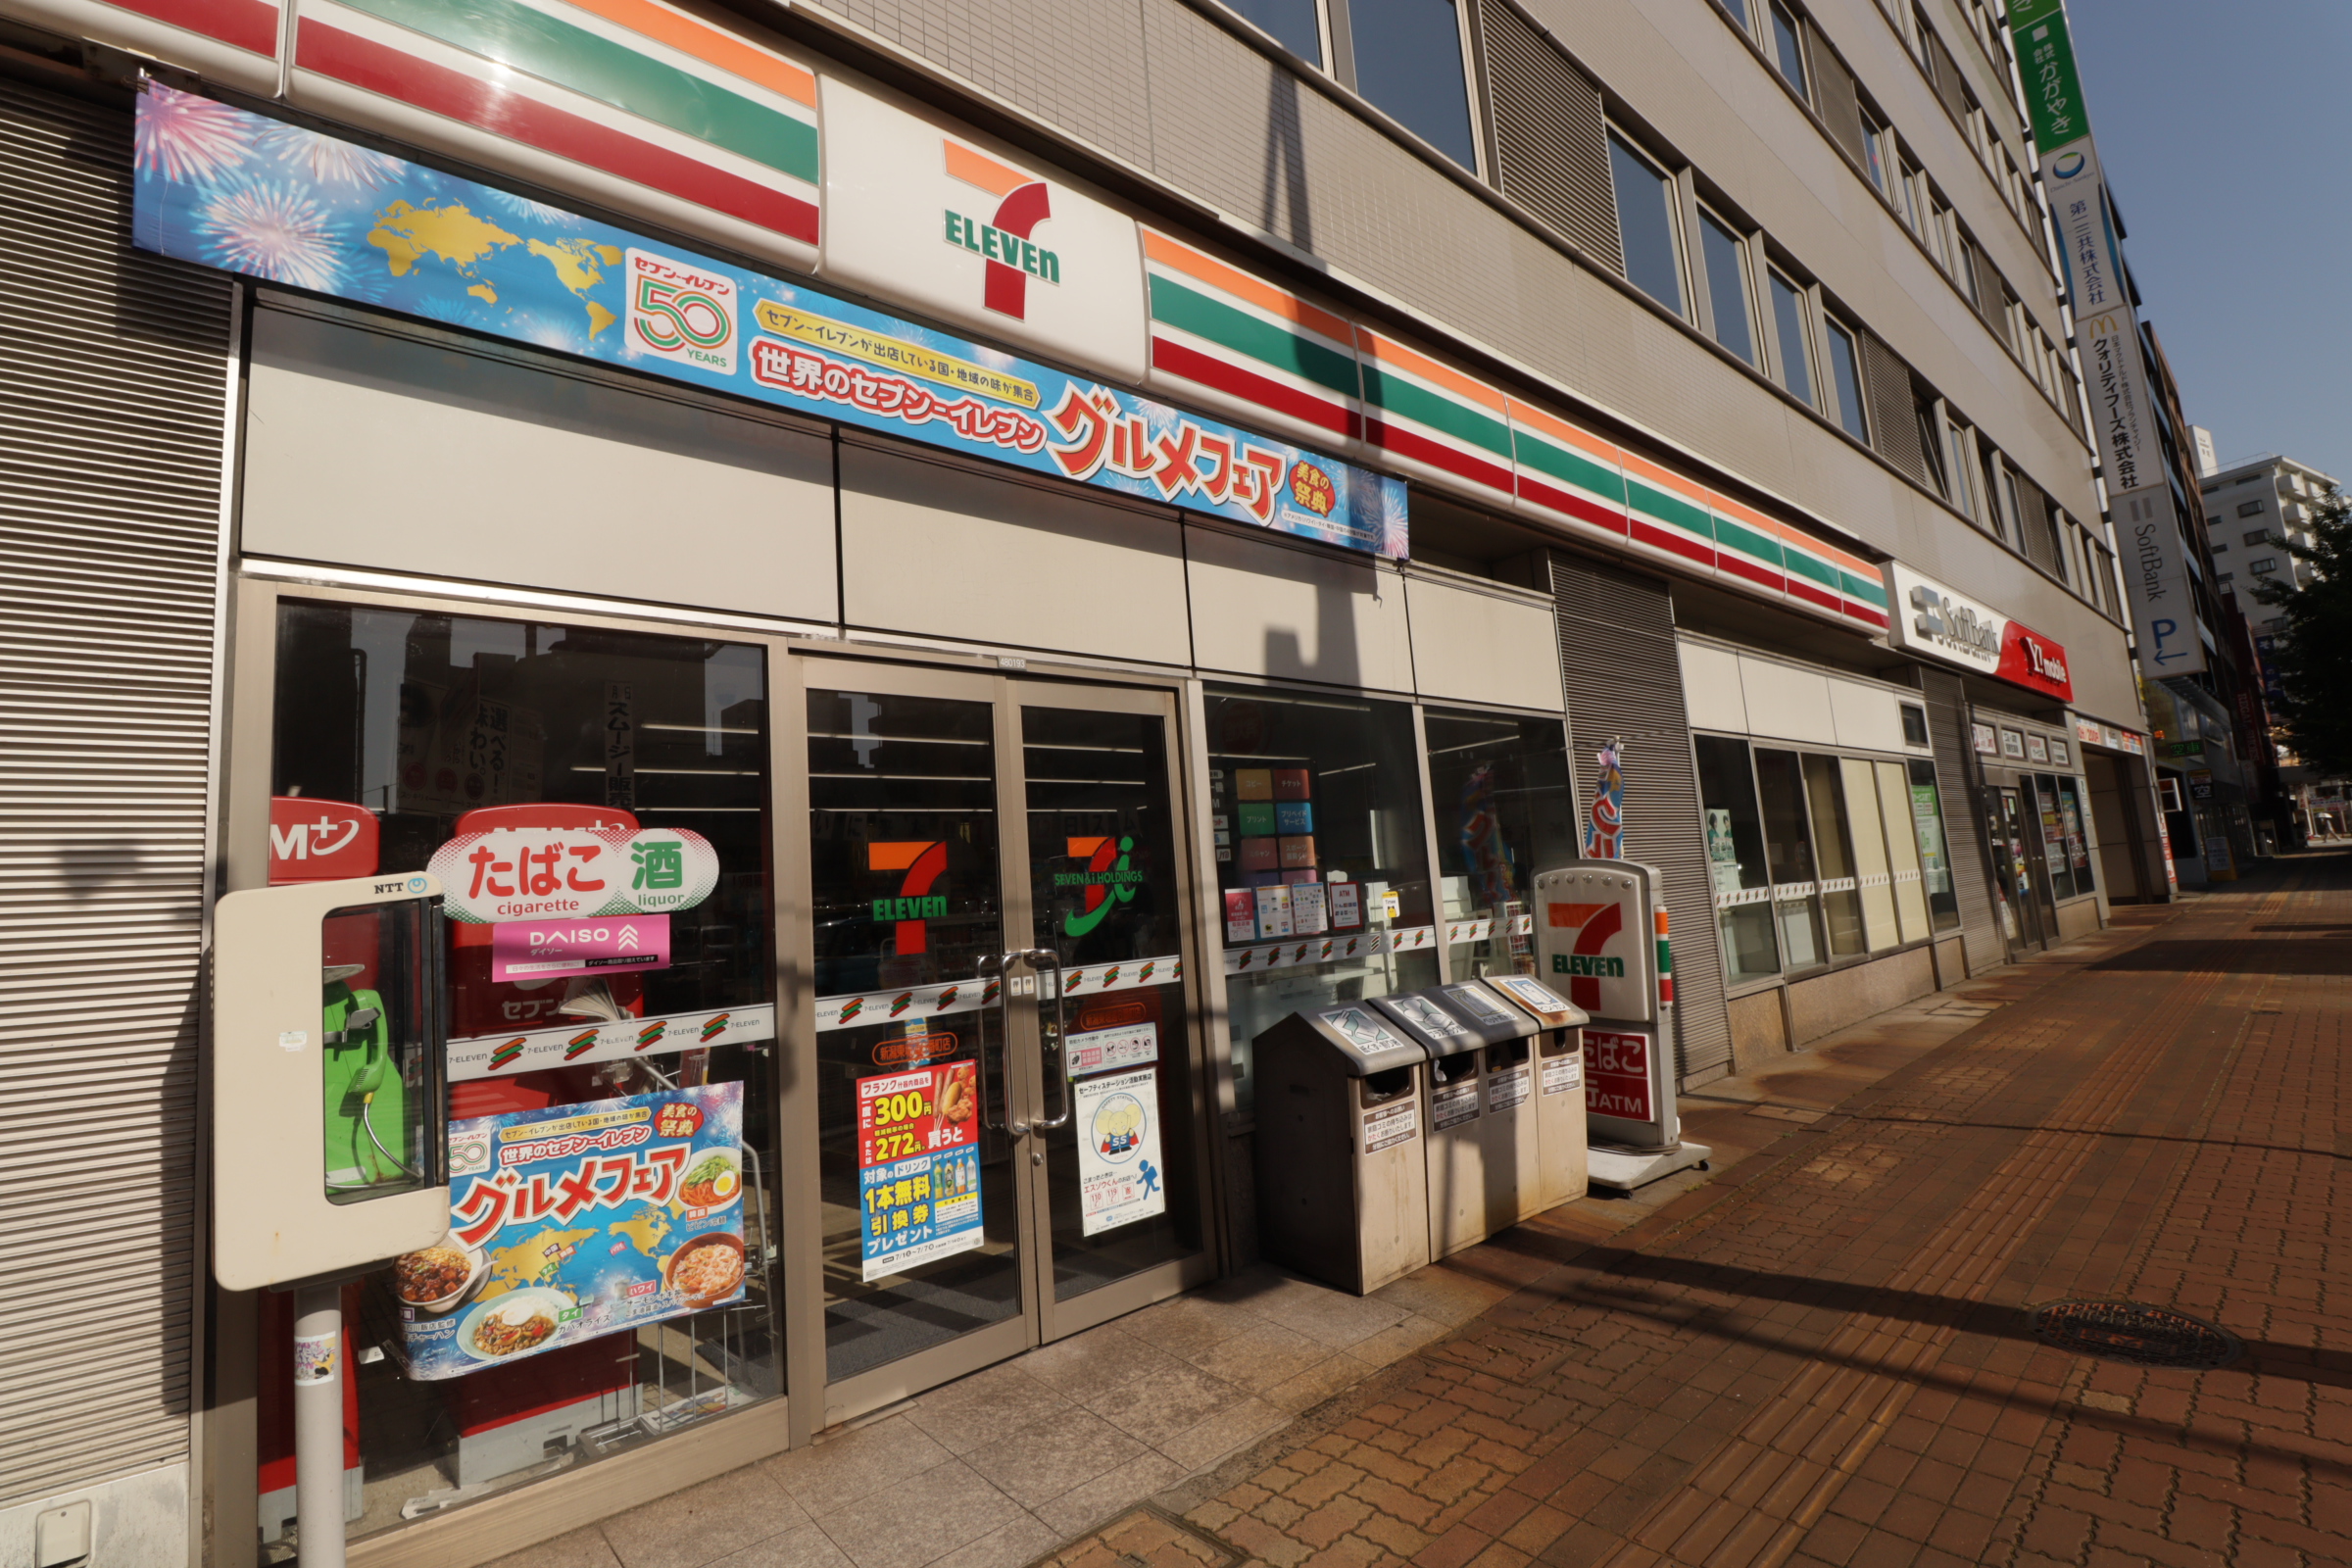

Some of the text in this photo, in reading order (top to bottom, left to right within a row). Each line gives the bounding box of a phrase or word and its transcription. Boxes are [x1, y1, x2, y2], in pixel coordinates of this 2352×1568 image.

[2038, 61, 2071, 134] かがやき
[2070, 199, 2106, 306] 第一三共株式会社
[687, 348, 727, 368] YEARS
[1049, 386, 1284, 521] グルメフェア
[1297, 462, 1330, 490] 美食の
[1295, 480, 1329, 517] 祭典
[2134, 523, 2167, 602] SoftBank
[1942, 597, 2001, 656] SoftBank
[2151, 618, 2177, 649] P
[1000, 658, 1025, 668] 480193
[608, 702, 633, 812] スムージー販売
[1281, 779, 1301, 788] チケット
[467, 842, 606, 901] たばこ
[630, 841, 683, 890] 酒
[1098, 870, 1143, 885] HOLDINGS
[374, 881, 405, 896] NTT
[497, 898, 580, 917] cigarette
[637, 890, 685, 908] liquor
[530, 928, 610, 947] DAISO
[529, 948, 563, 956] ダイソー
[1079, 1073, 1152, 1095] セーフティステーション活動実施店
[662, 1103, 698, 1118] 美食の
[861, 1100, 872, 1129] 一度に
[660, 1119, 695, 1137] 祭典
[927, 1126, 963, 1149] 買うと
[1112, 1135, 1127, 1147] SS
[864, 1140, 873, 1164] または
[458, 1147, 687, 1246] グルメフェア
[864, 1174, 931, 1214] 1本無料
[1091, 1193, 1102, 1201] 110
[1107, 1188, 1118, 1198] 119
[688, 1208, 707, 1219] 韓国
[871, 1204, 929, 1237] 引換券
[544, 1244, 560, 1256] 中国
[867, 1225, 933, 1255] プレゼント
[541, 1263, 554, 1275] タイ
[629, 1283, 655, 1296] ハワイ
[561, 1308, 580, 1321] タイ
[403, 1319, 455, 1331] 四川飯店監修
